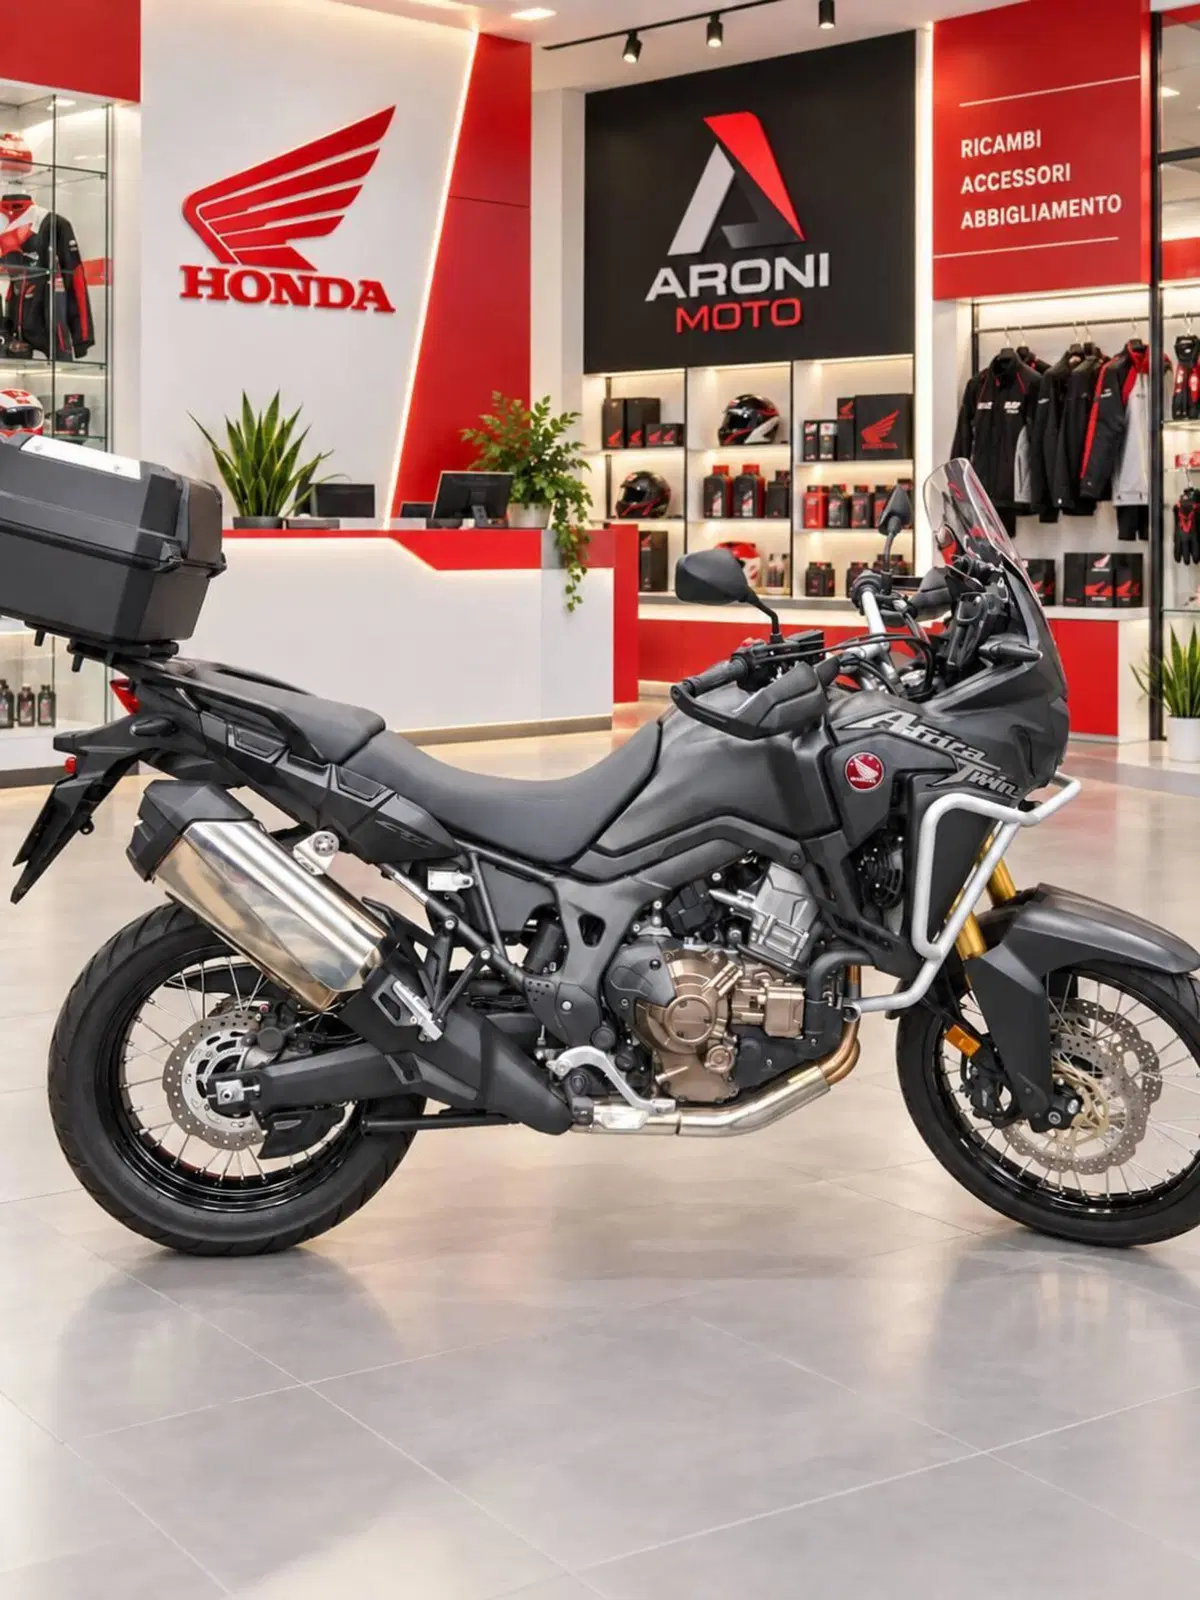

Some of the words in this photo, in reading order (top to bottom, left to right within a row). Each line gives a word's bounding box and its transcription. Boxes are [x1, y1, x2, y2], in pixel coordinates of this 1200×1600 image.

[960, 129, 1042, 159] RICAMBI
[960, 162, 1072, 195] ACCESSORI
[960, 193, 1123, 230] ABBIGLIAMENTO
[179, 265, 397, 314] HONDA
[644, 252, 830, 302] ARONI
[675, 297, 802, 334] MOTO
[842, 710, 1002, 771] Africa
[930, 757, 1019, 800] Twin
